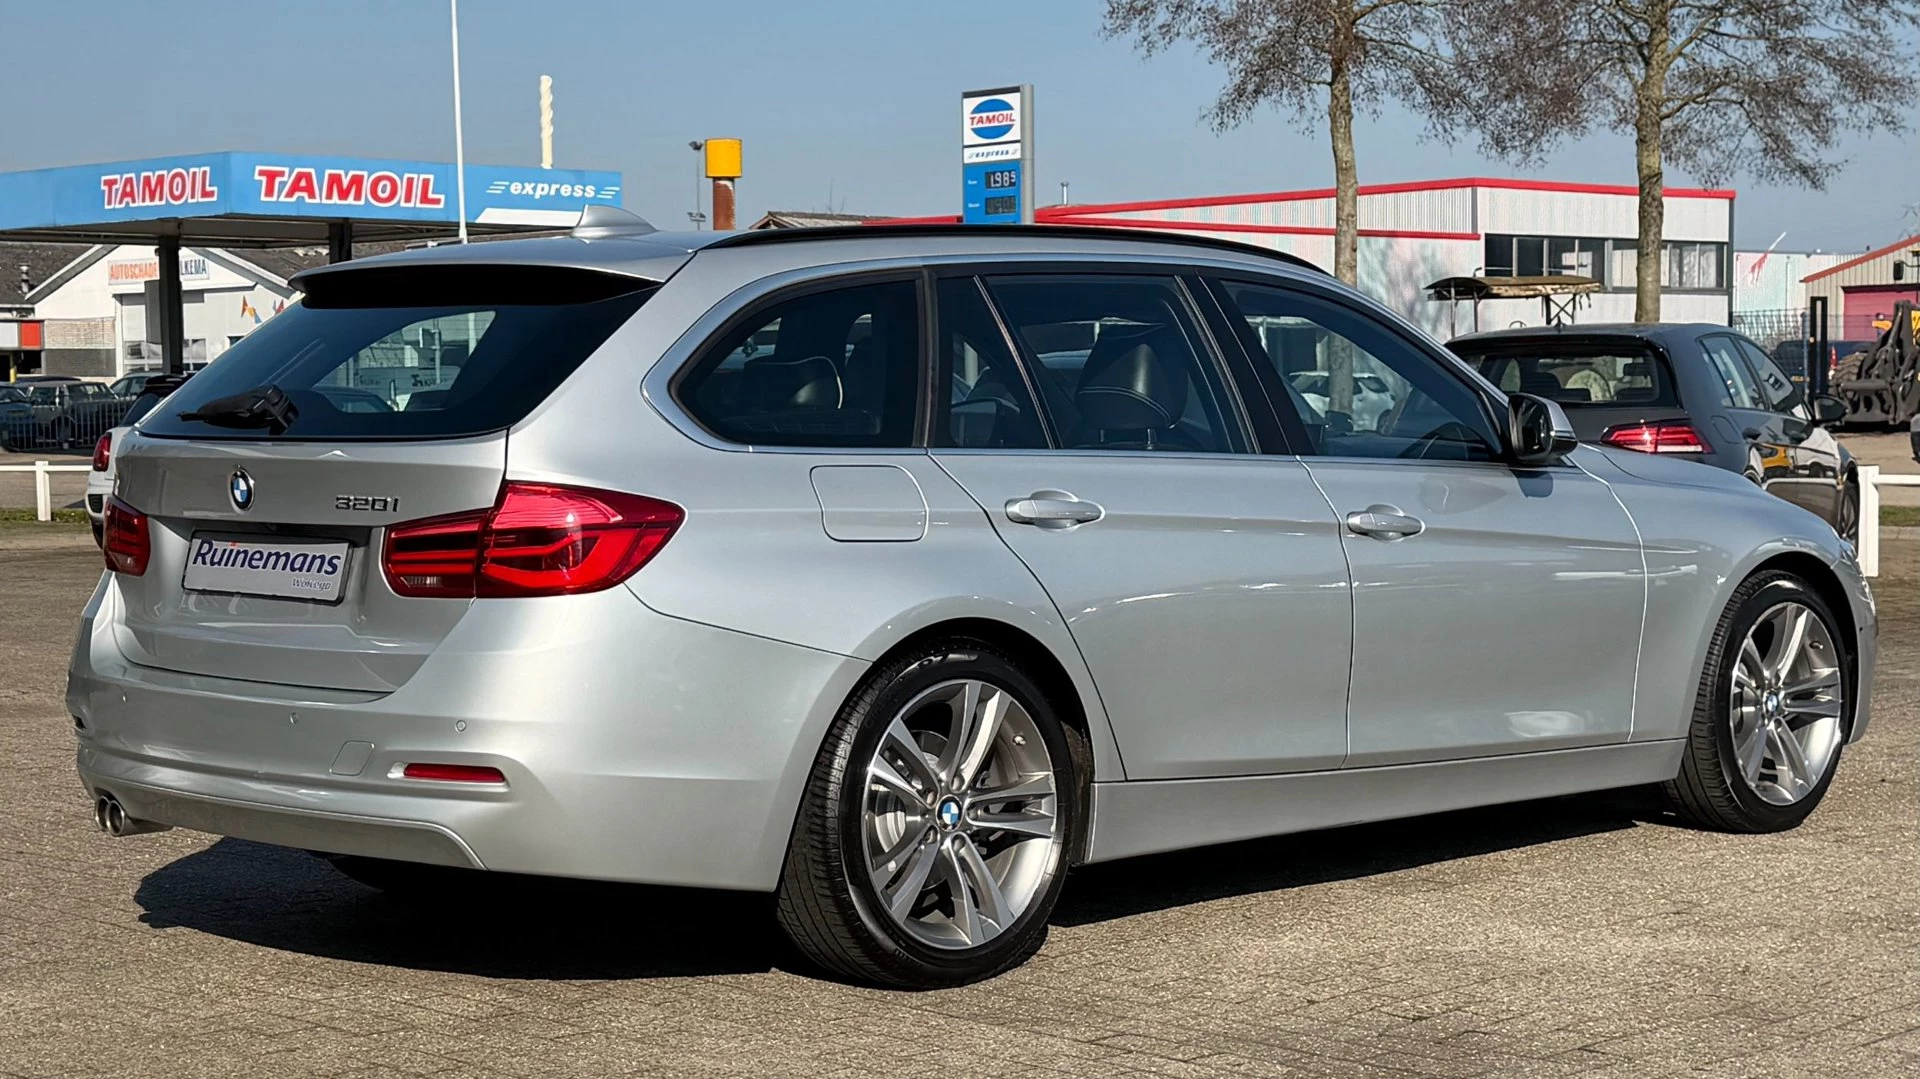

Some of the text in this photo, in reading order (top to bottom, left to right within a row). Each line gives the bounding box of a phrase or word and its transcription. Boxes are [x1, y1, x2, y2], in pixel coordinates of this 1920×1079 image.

[970, 113, 1016, 126] TAMOIL
[975, 149, 1010, 159] express
[101, 166, 218, 209] TAMOIL
[254, 165, 445, 208] TAMOIL
[509, 181, 596, 199] express
[336, 496, 399, 513] 320i
[192, 538, 341, 575] Ruinemans
